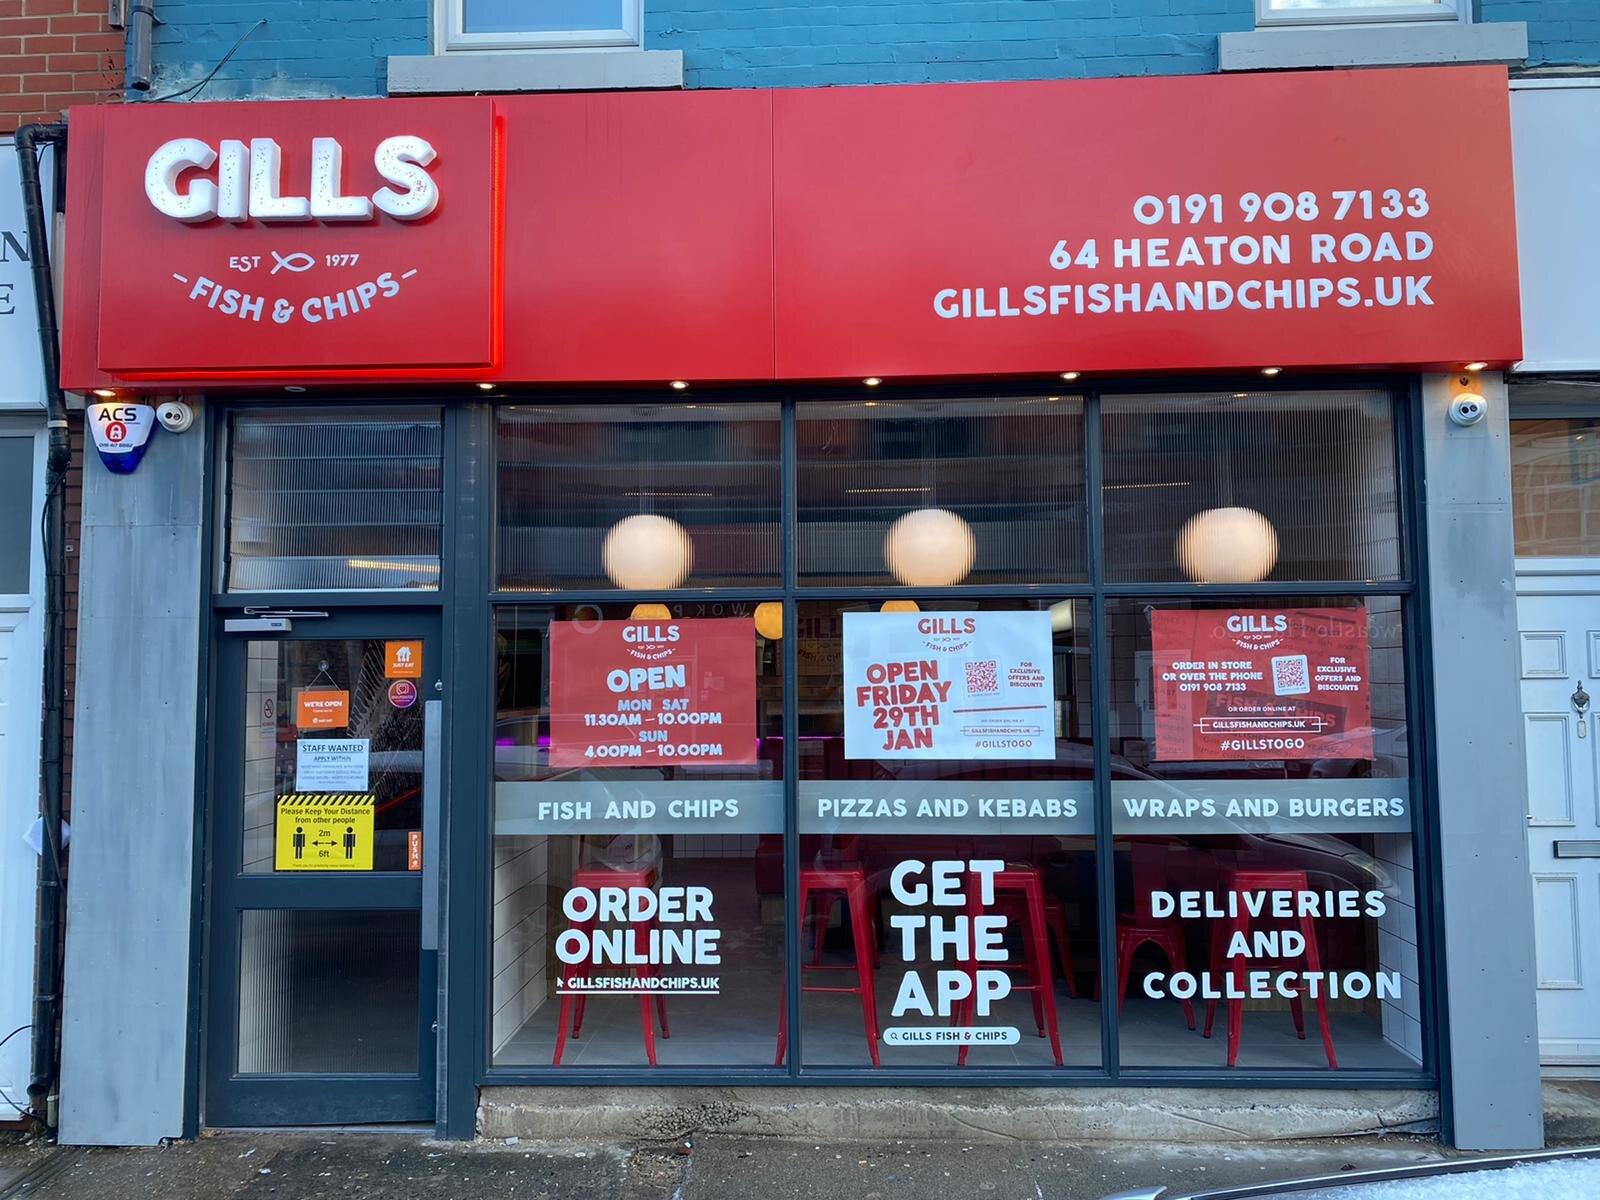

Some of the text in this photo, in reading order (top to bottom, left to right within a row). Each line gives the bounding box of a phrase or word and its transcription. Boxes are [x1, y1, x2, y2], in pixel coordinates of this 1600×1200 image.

[145, 135, 439, 223] GILLS
[1133, 187, 1430, 226] 0191 908 7133
[1049, 230, 1434, 270] 64 HEATON ROAD
[229, 253, 360, 272] EST 1977
[188, 271, 400, 324] FISH & CHIPS
[933, 275, 1435, 320] GILLSFISHANDCHIPS.UK
[98, 407, 137, 421] ACS
[918, 617, 976, 634] GILLS
[1226, 614, 1288, 632] GILLS
[622, 624, 680, 642] GILLS
[926, 642, 941, 652] FISH
[949, 641, 969, 652] CHIPS
[1235, 639, 1252, 650] FISH
[1259, 638, 1280, 650] CHIPS
[630, 649, 646, 660] FISH
[652, 648, 673, 660] CHIPS
[866, 660, 939, 685] OPEN
[1172, 661, 1253, 670] ORDER IN STORE
[606, 664, 686, 693] OPEN
[1162, 671, 1263, 681] OR OVER THE PHONE
[1314, 674, 1361, 682] OFFERS AND
[856, 680, 952, 708] FRIDAY
[1179, 682, 1247, 692] 0191 908 7133
[1317, 683, 1359, 691] DISCOUNTS
[617, 698, 689, 711] MON SAT
[584, 713, 642, 726] 11.30AM
[657, 712, 722, 725] 10.00PM
[872, 705, 939, 730] 29TH
[1212, 720, 1306, 729] GILLSFISHANDCHIPS.UK
[639, 730, 668, 742] SUN
[882, 727, 933, 751] JAN
[975, 740, 1033, 749] #GILLSTOGO
[1220, 738, 1305, 751] #GILLSTOGO
[302, 744, 364, 752] STAFF WANTED
[584, 745, 642, 758] 4.00PM
[657, 743, 723, 757] 10.00PM
[280, 807, 371, 817] Please Keep Your Distance
[538, 798, 739, 820] FISH AND CHIPS
[818, 798, 1078, 818] PIZZAS AND KEBABS
[1122, 797, 1405, 817] WRAPS AND BURGERS
[332, 816, 356, 825] people
[318, 829, 331, 837] 2m
[318, 850, 330, 858] 6ft
[890, 859, 1005, 906] GET
[562, 886, 714, 923] ORDER
[1151, 890, 1387, 919] DELIVERIES
[555, 929, 721, 965] ONLINE
[890, 915, 1009, 962] THE
[1226, 930, 1306, 959] AND
[567, 976, 720, 989] GILLSFISHANDCHIPS.UK
[1143, 970, 1402, 1000] COLLECTION
[891, 970, 1012, 1017] APP
[902, 1031, 1008, 1041] GILLS FISH & CHIPS
